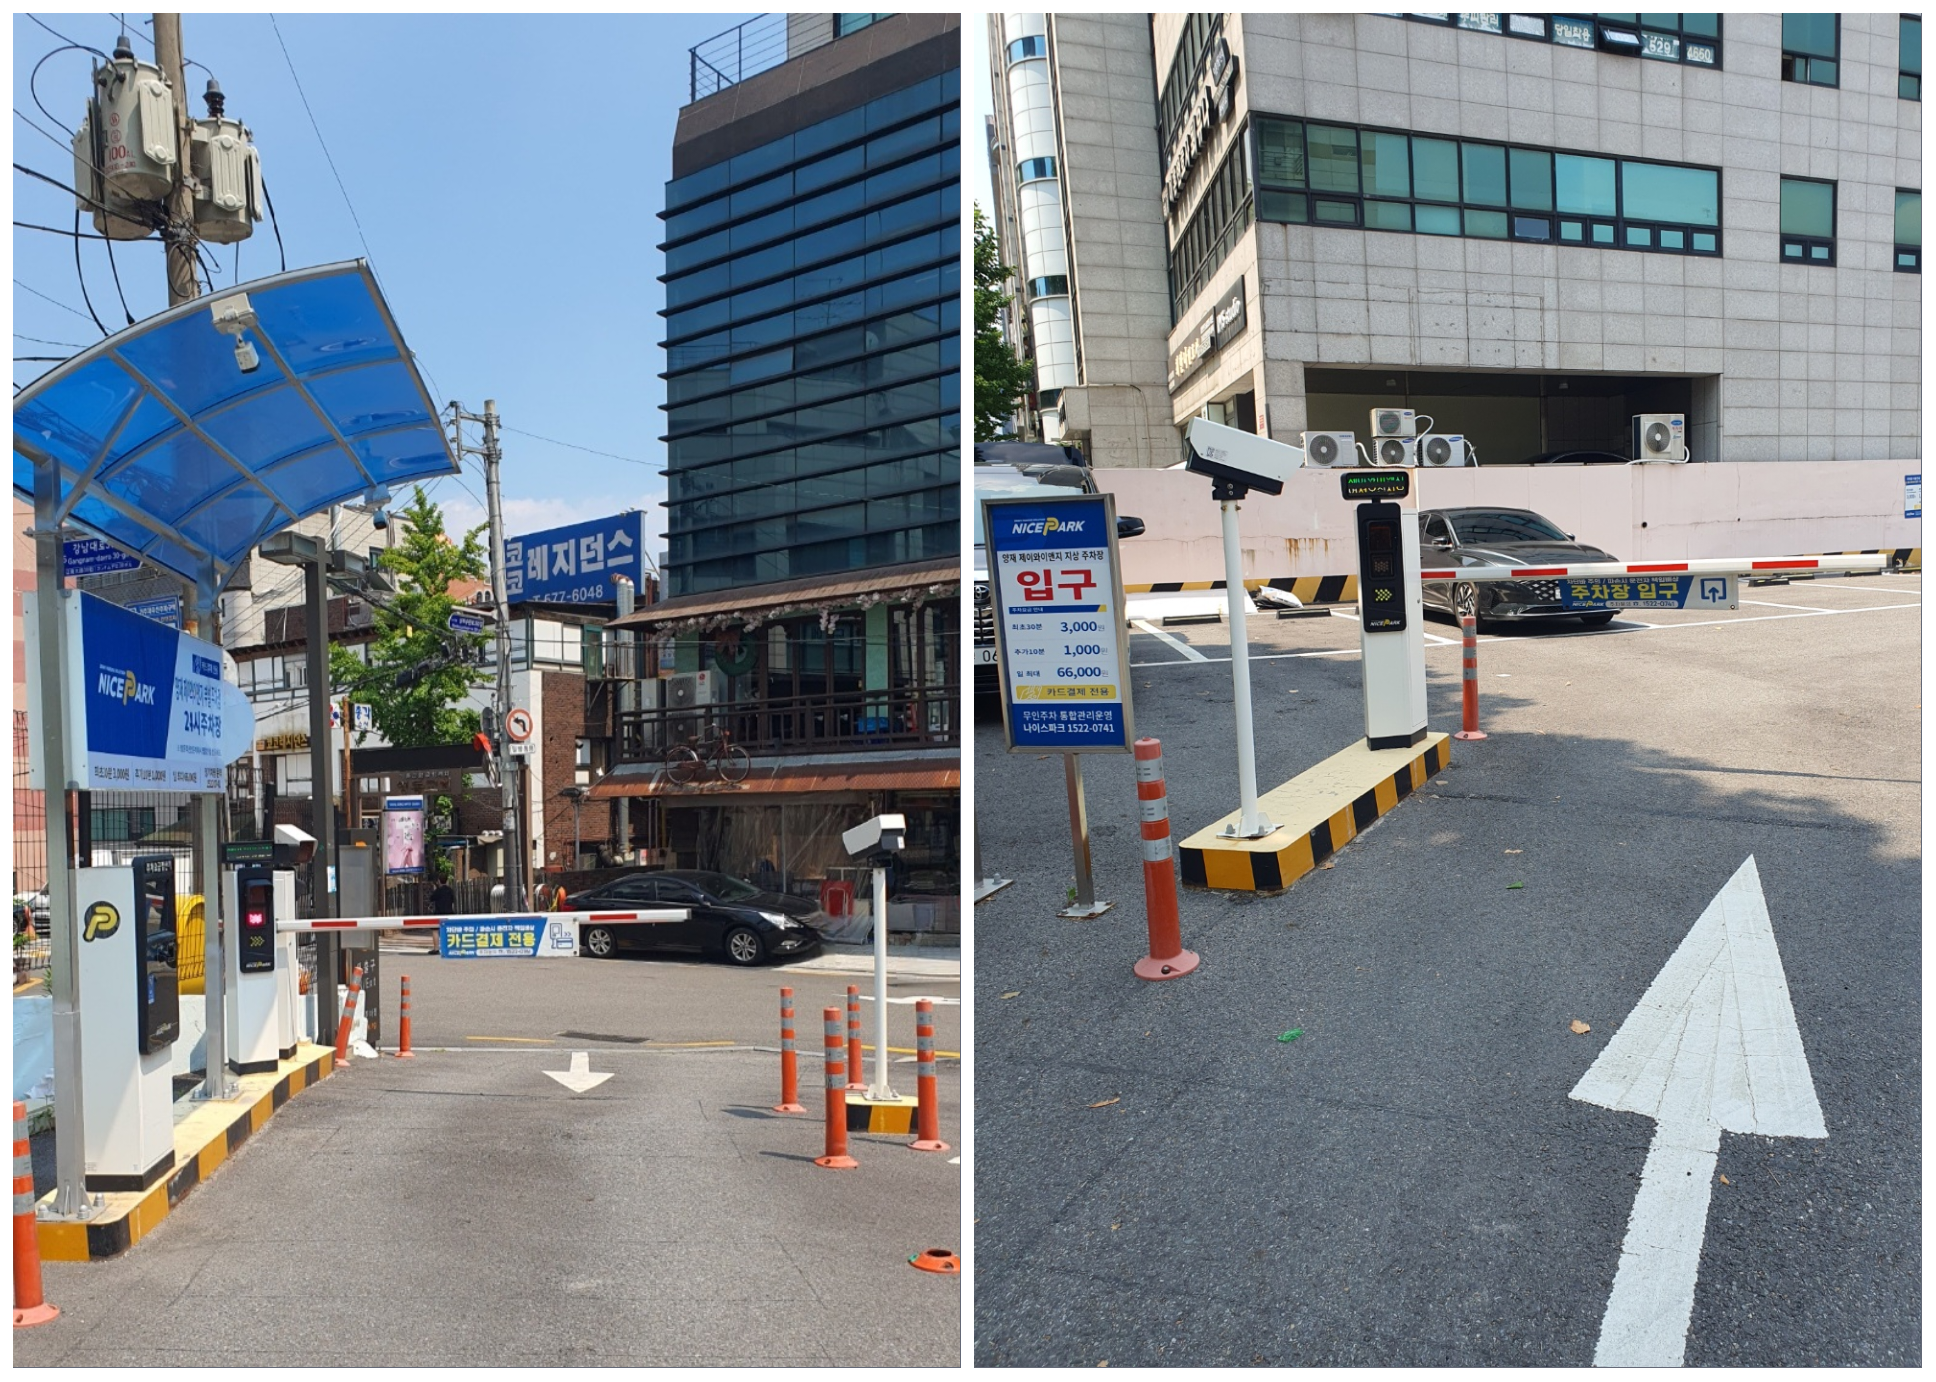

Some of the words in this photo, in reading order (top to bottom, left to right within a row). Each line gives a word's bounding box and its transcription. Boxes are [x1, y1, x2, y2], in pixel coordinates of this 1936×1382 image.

[1011, 517, 1085, 536] NICEPARK
[73, 540, 113, 555] 강남대로
[527, 529, 634, 582] 레지던스
[1002, 553, 1017, 563] 양재
[1065, 551, 1079, 561] 지상
[1082, 550, 1104, 561] 주차장
[1016, 569, 1097, 602] 입구
[1571, 584, 1631, 600] 주차장
[1637, 582, 1679, 599] 입구
[1012, 623, 1043, 631] 최초30분
[98, 670, 155, 706] NICEPARK
[1047, 687, 1086, 697] 카드결제
[1090, 687, 1109, 696] 전용
[1023, 711, 1057, 721] 무인주차
[1060, 710, 1113, 721] 통합관리운영
[1023, 723, 1066, 734] 나이스파크
[1068, 723, 1115, 733] 1522-0741
[447, 932, 503, 948] 카드결제
[508, 932, 536, 947] 전용
